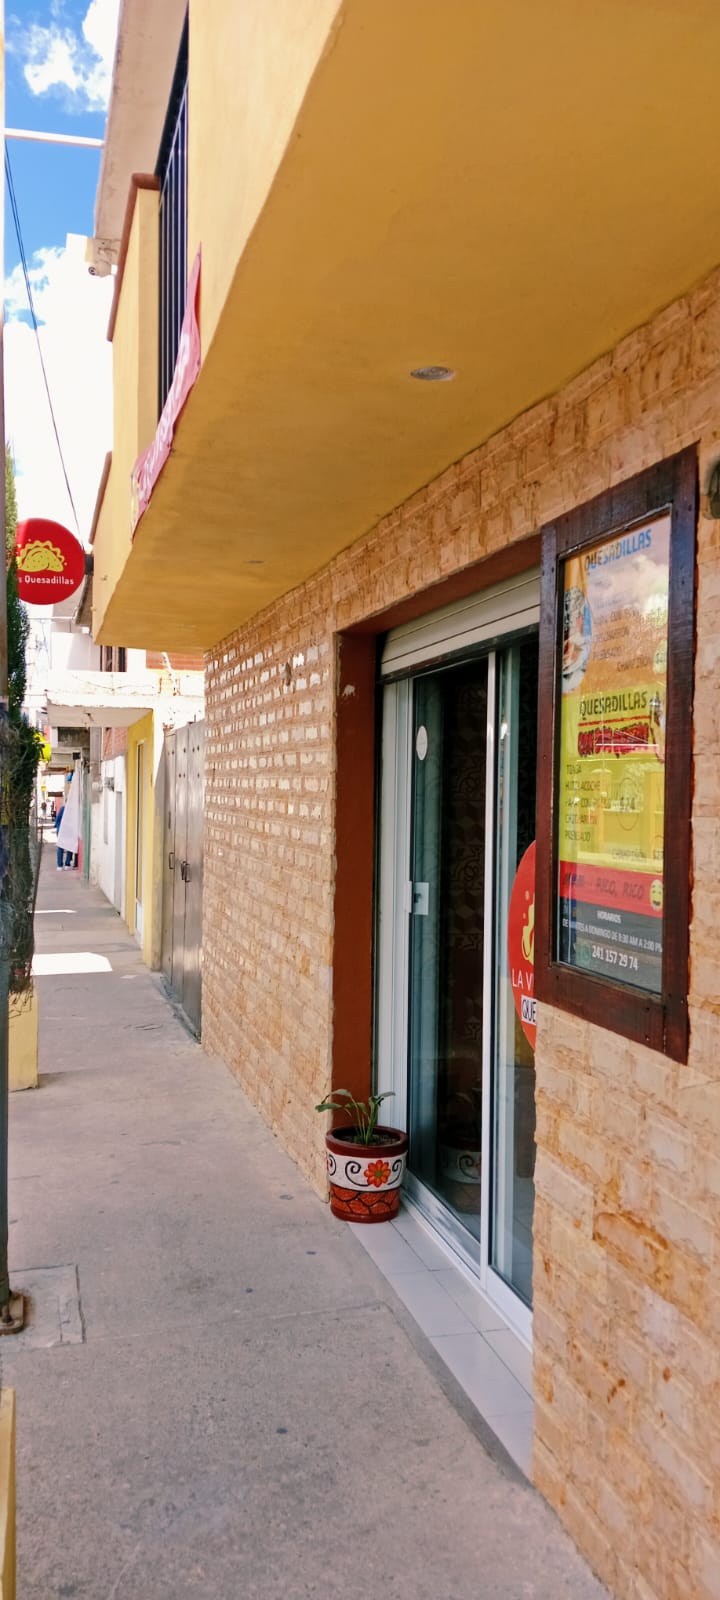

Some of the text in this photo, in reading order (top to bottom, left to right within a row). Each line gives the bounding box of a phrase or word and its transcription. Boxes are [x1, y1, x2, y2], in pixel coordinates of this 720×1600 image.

[584, 528, 652, 576] QUESADILLAS
[24, 575, 74, 585] Quesadillas
[580, 691, 648, 720] QUESADILLAS
[592, 945, 604, 960] 241
[605, 948, 617, 964] 157
[629, 954, 638, 971] 74
[512, 968, 523, 989] LA
